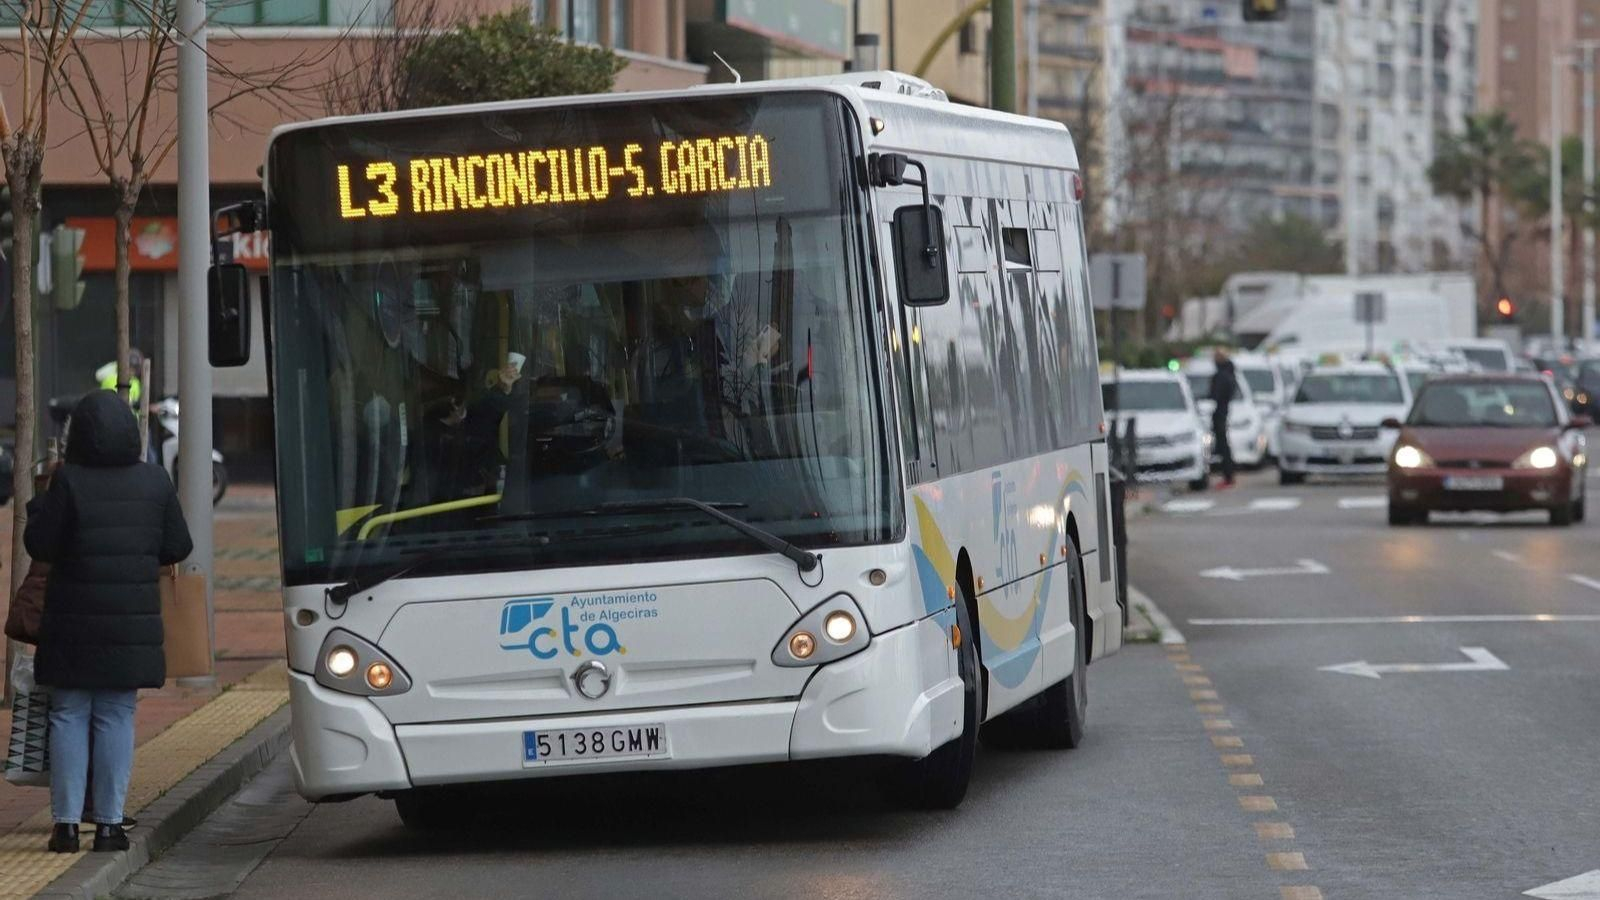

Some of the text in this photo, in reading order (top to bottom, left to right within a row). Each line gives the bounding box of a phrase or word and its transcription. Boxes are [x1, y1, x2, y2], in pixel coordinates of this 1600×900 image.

[337, 161, 399, 218] L3
[660, 134, 771, 194] GARCIA
[570, 591, 657, 609] Ayuntamiento
[580, 608, 658, 623] de Algeciras
[528, 606, 626, 660] cta
